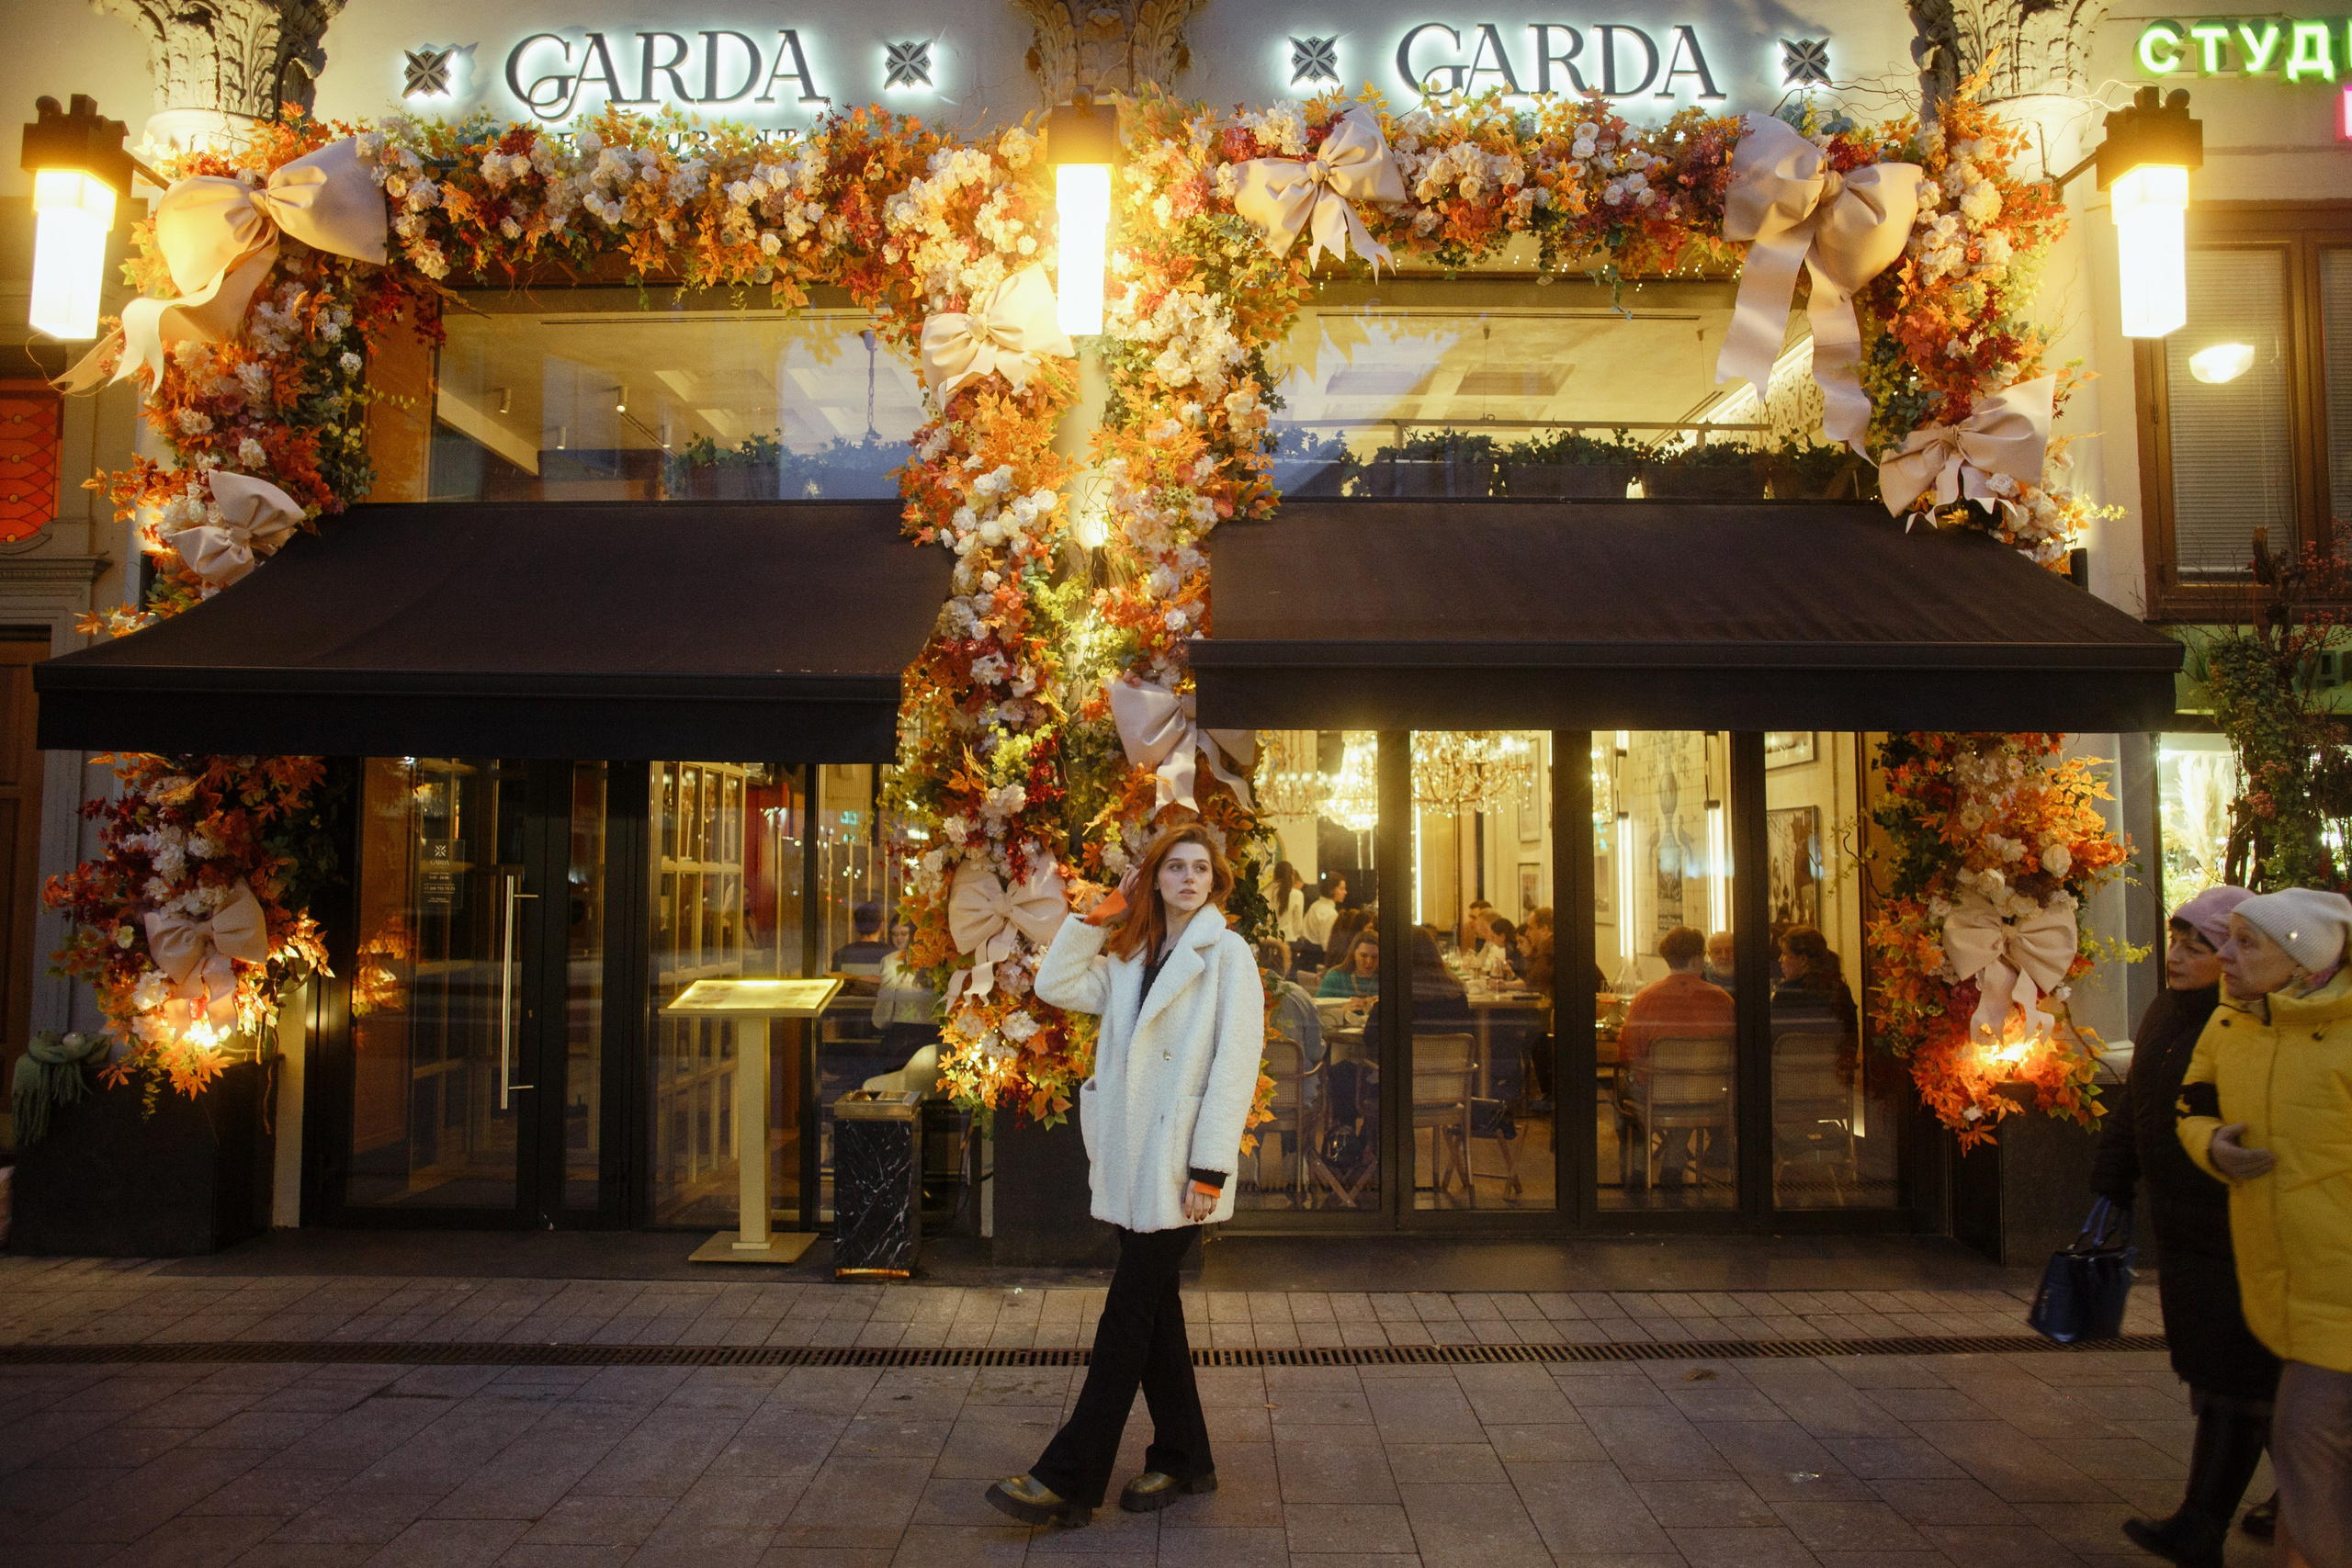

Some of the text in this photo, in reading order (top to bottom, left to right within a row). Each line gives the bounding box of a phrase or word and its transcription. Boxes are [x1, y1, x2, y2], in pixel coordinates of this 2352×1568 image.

[504, 28, 830, 123] GARDA
[1395, 22, 1728, 108] GARDA
[2137, 21, 2352, 84] СТУД
